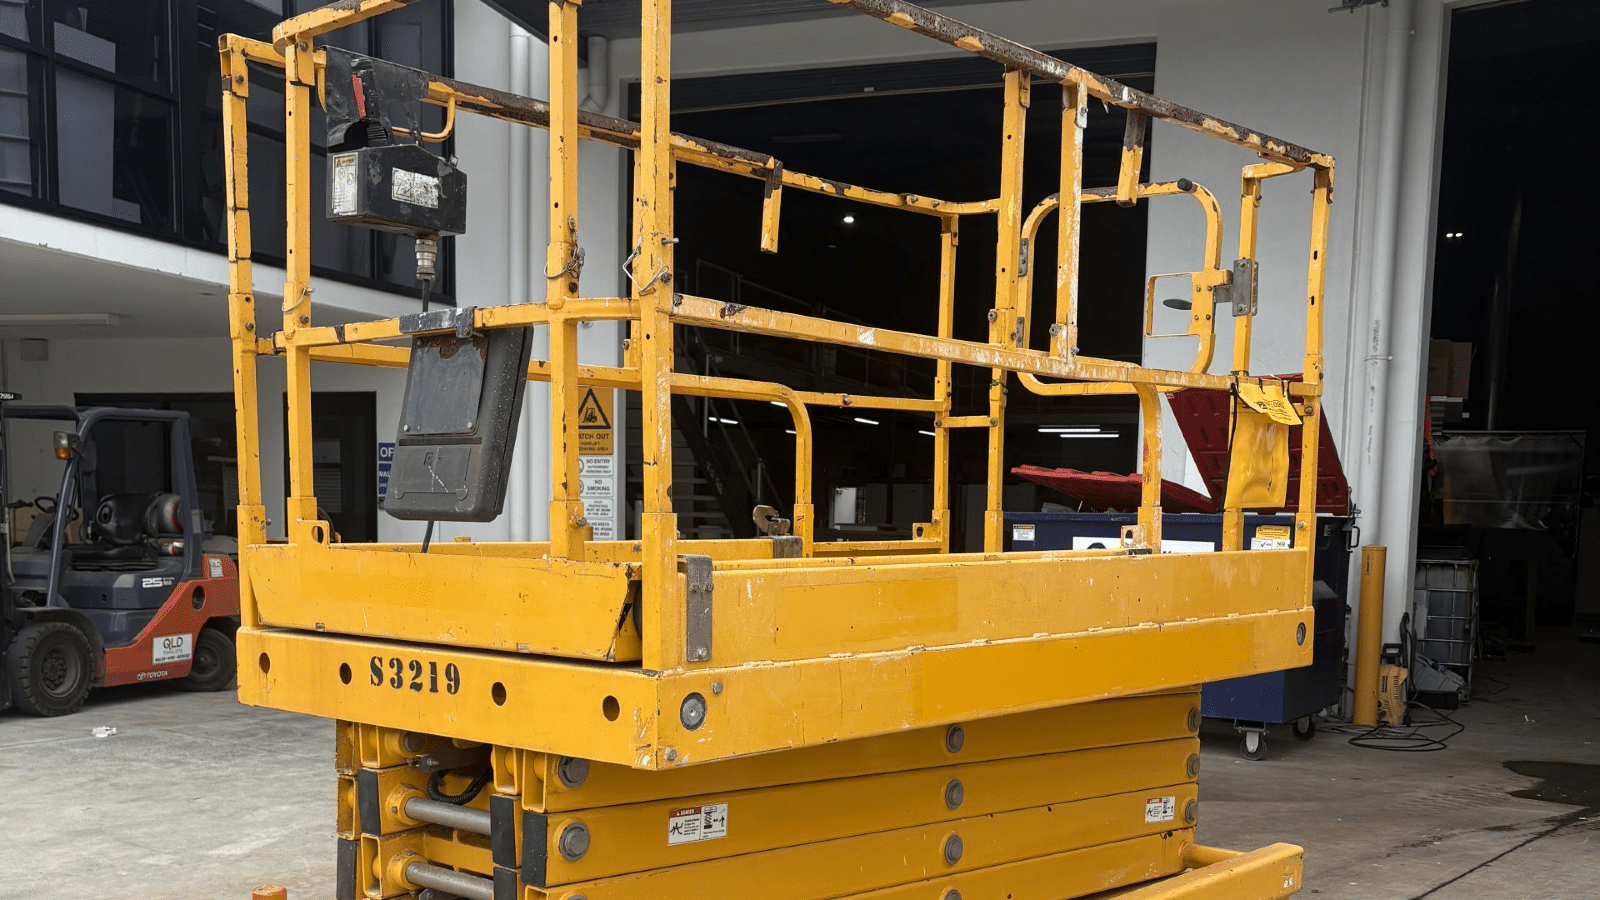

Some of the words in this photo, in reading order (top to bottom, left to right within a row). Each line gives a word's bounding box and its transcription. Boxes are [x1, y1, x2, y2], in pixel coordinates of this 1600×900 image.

[380, 447, 394, 457] OF
[142, 577, 163, 588] 25
[163, 637, 184, 650] QLD
[370, 656, 461, 695] S3219
